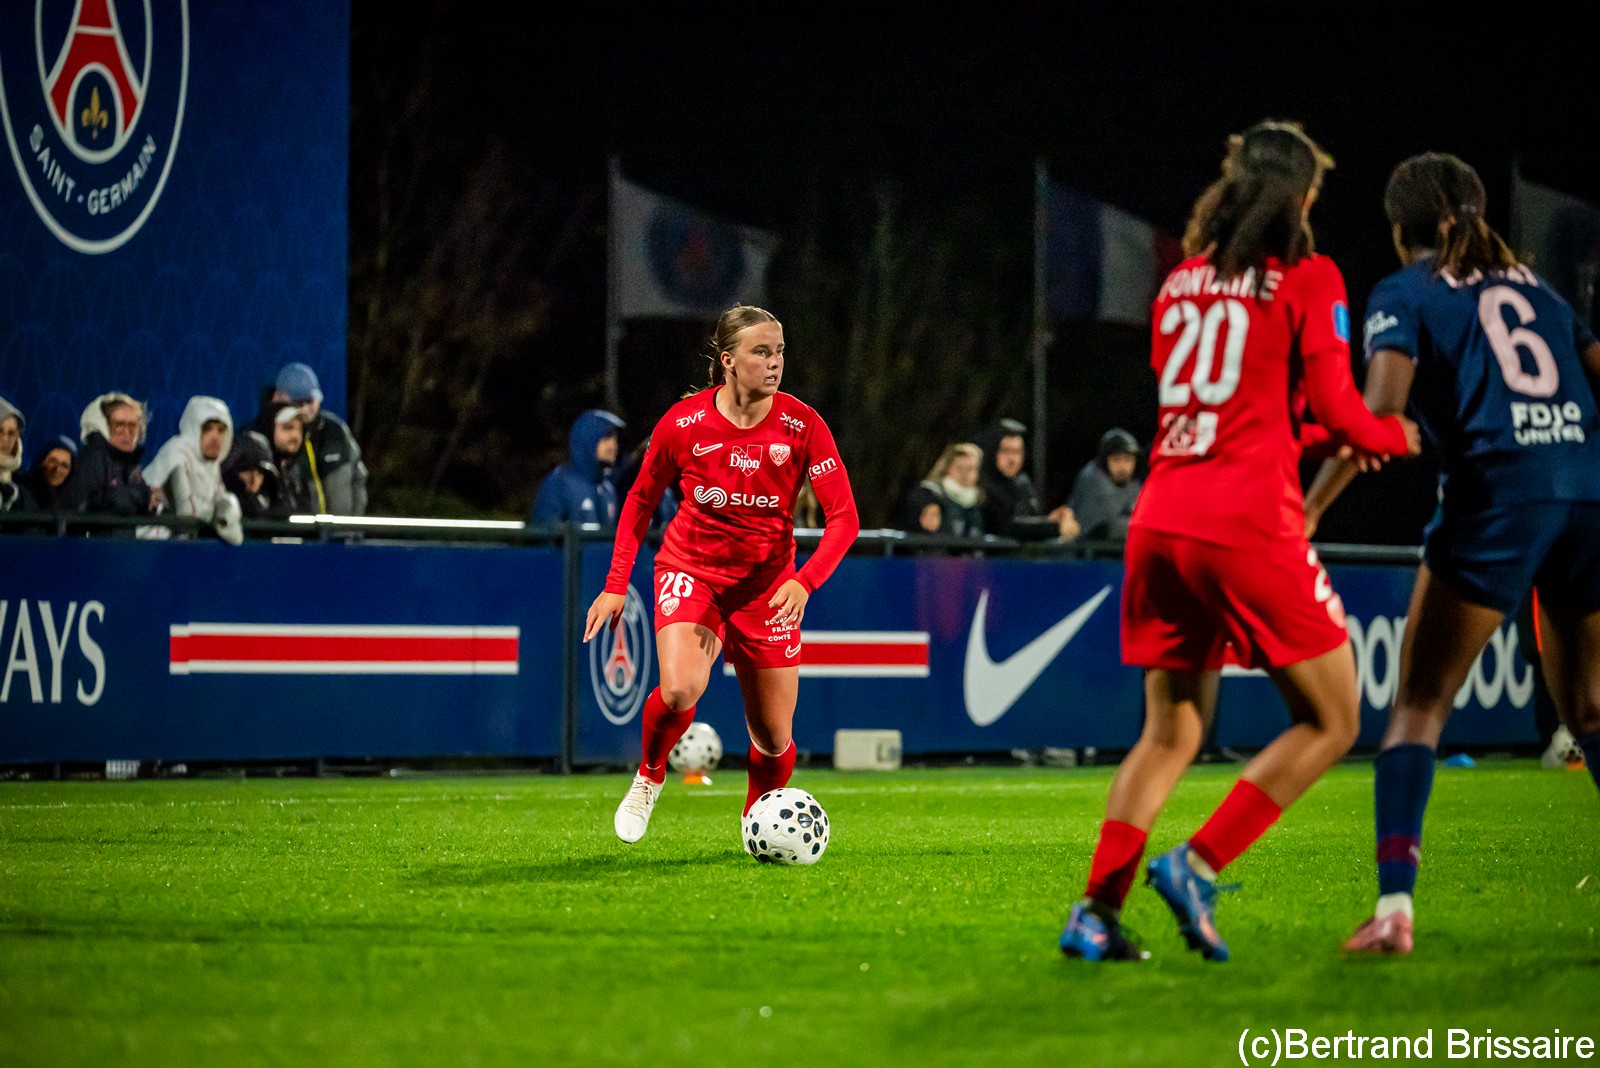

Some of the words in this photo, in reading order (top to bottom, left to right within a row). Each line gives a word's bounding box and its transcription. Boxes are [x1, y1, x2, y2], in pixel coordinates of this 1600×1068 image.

[29, 123, 76, 203] SAINT
[87, 134, 157, 216] GERMAIN
[1159, 299, 1249, 407] 20
[1478, 285, 1559, 398] 6
[729, 453, 760, 472] Dijon
[730, 493, 780, 508] suez
[658, 572, 695, 604] 26
